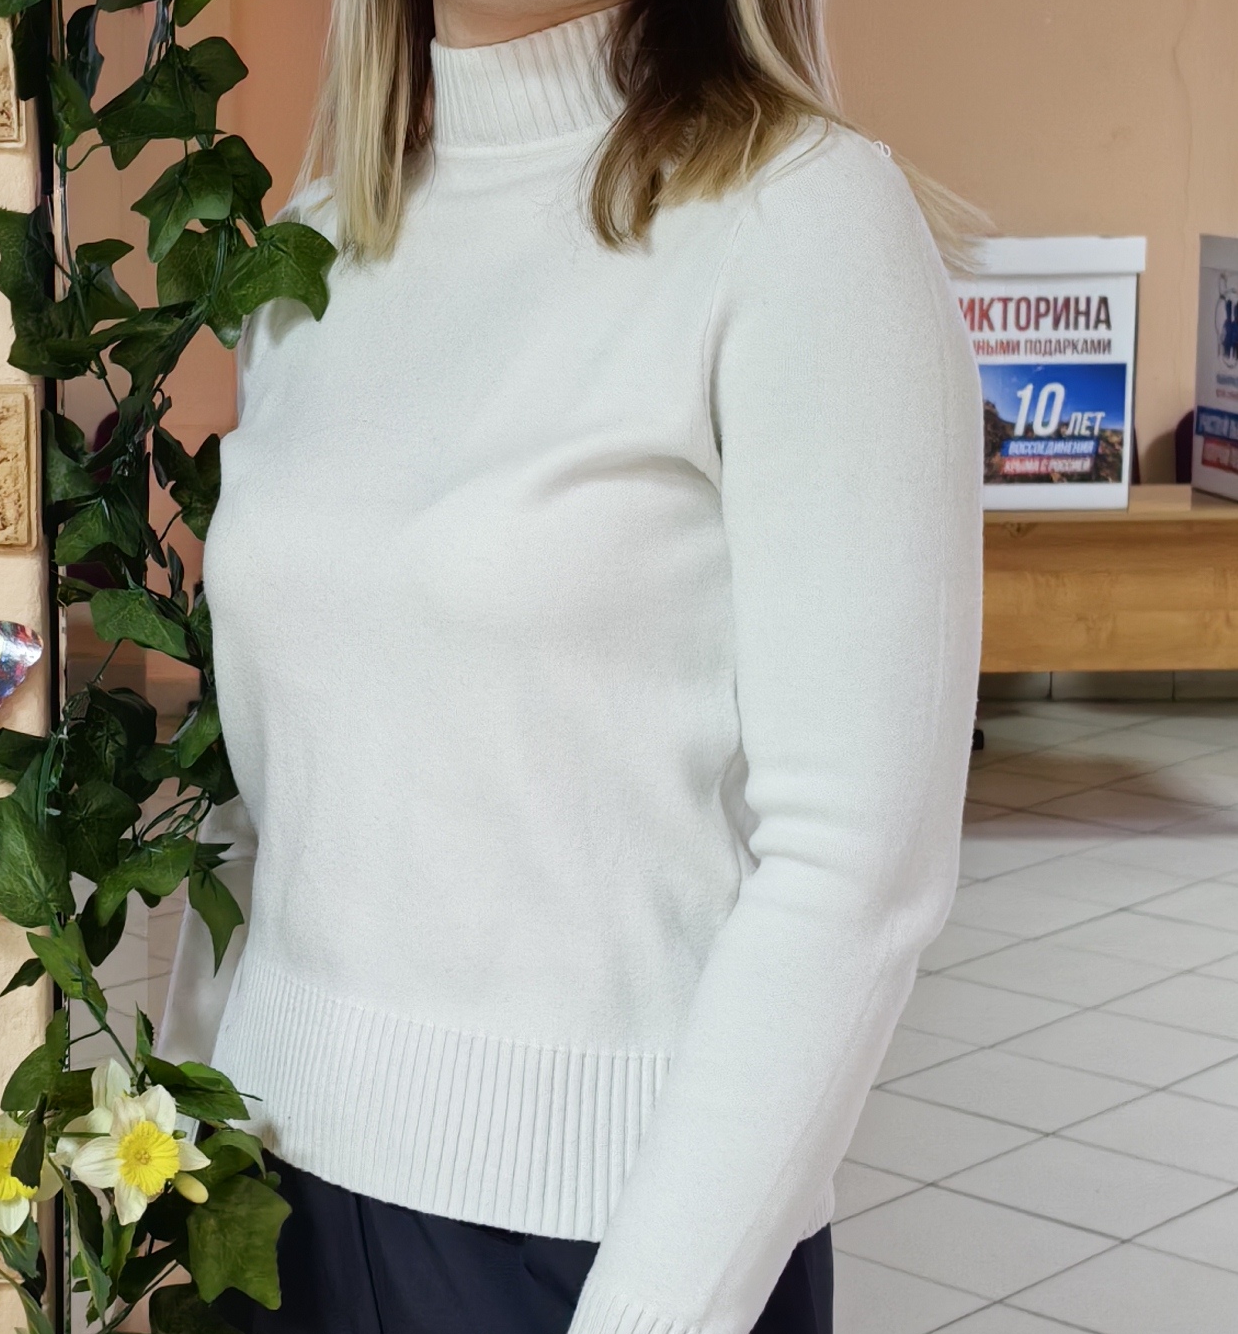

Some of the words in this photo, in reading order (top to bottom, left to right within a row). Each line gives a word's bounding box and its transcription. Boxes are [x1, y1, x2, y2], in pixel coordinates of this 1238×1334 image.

[1024, 338, 1112, 358] ПОДАРКАМИ
[1014, 382, 1065, 436] 10
[1065, 411, 1105, 436] ЛЕТ
